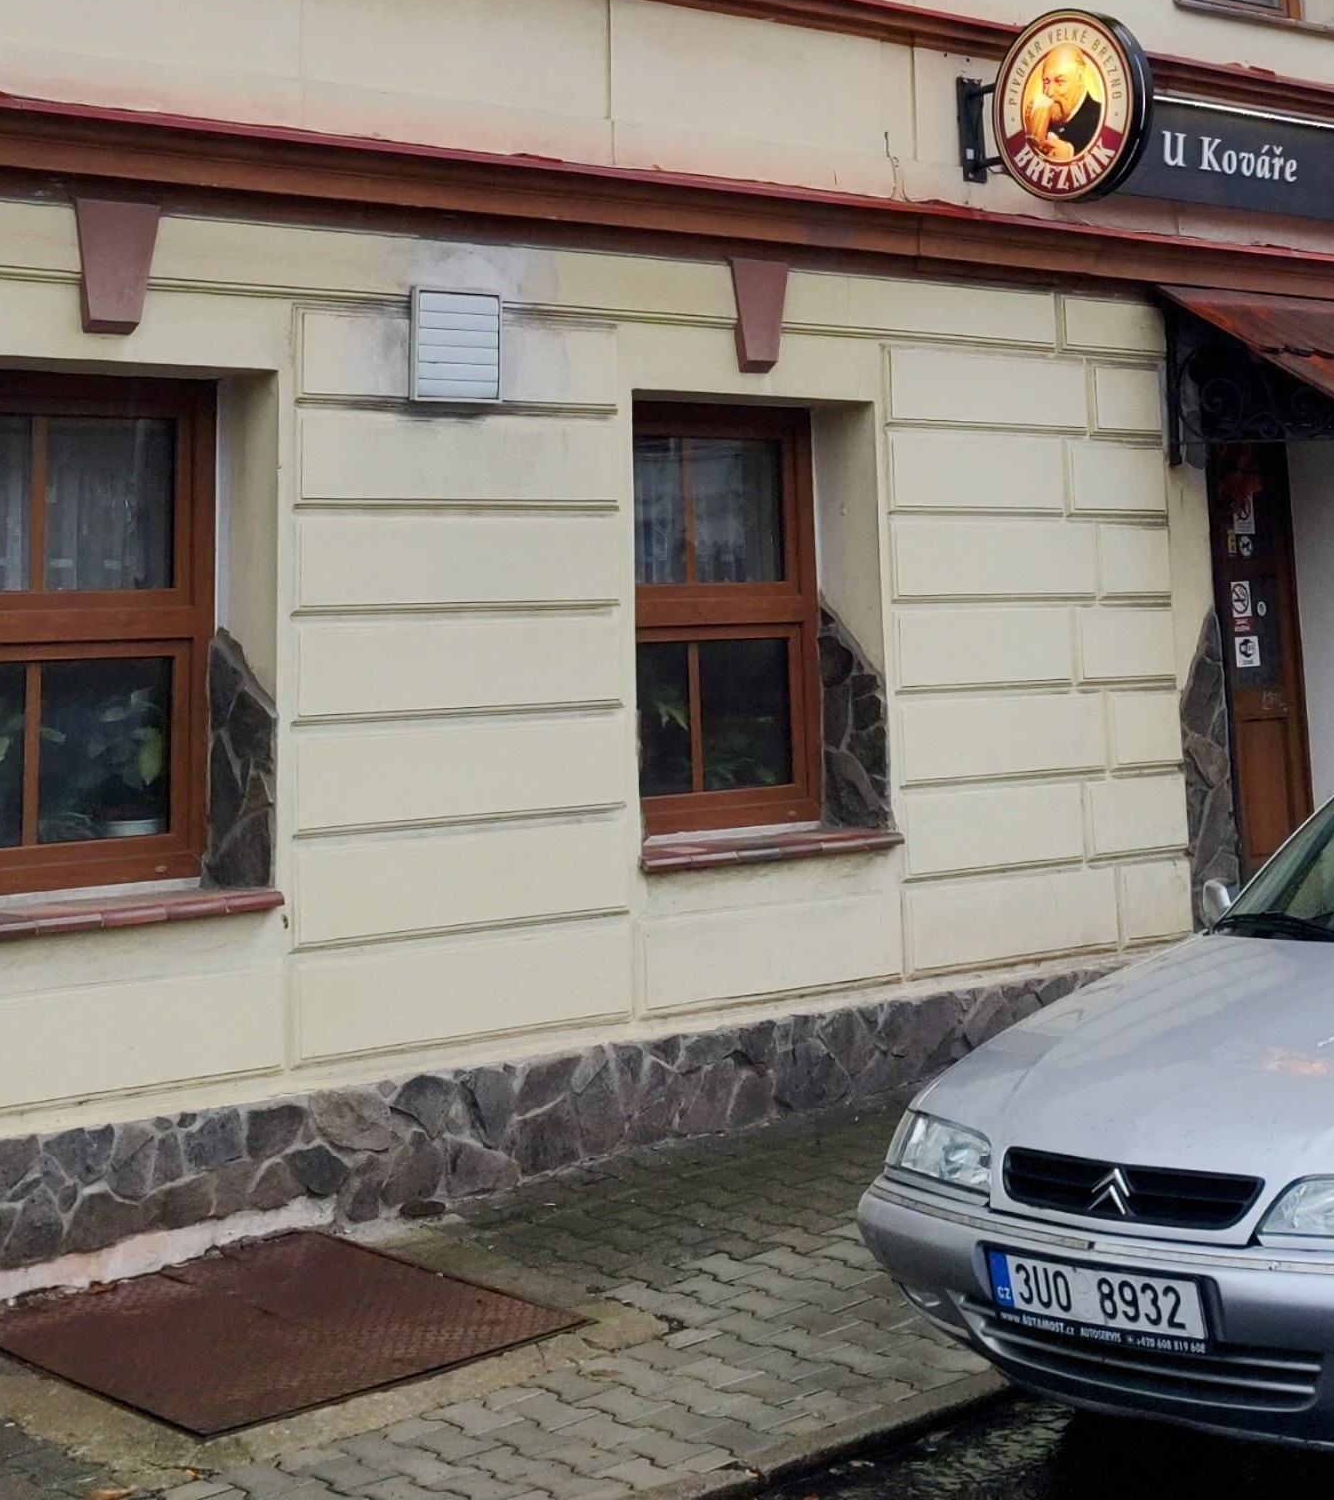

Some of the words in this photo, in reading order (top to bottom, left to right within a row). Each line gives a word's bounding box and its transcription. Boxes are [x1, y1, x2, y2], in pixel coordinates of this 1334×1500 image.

[1008, 41, 1042, 106] PIVOVAR
[1047, 27, 1089, 44] VELKÉ
[1162, 130, 1187, 167] U
[1198, 136, 1298, 182] Kováře
[997, 1286, 1011, 1300] CZ
[1097, 1277, 1187, 1330] 8932
[1080, 1326, 1122, 1343] AUTOSERVIS
